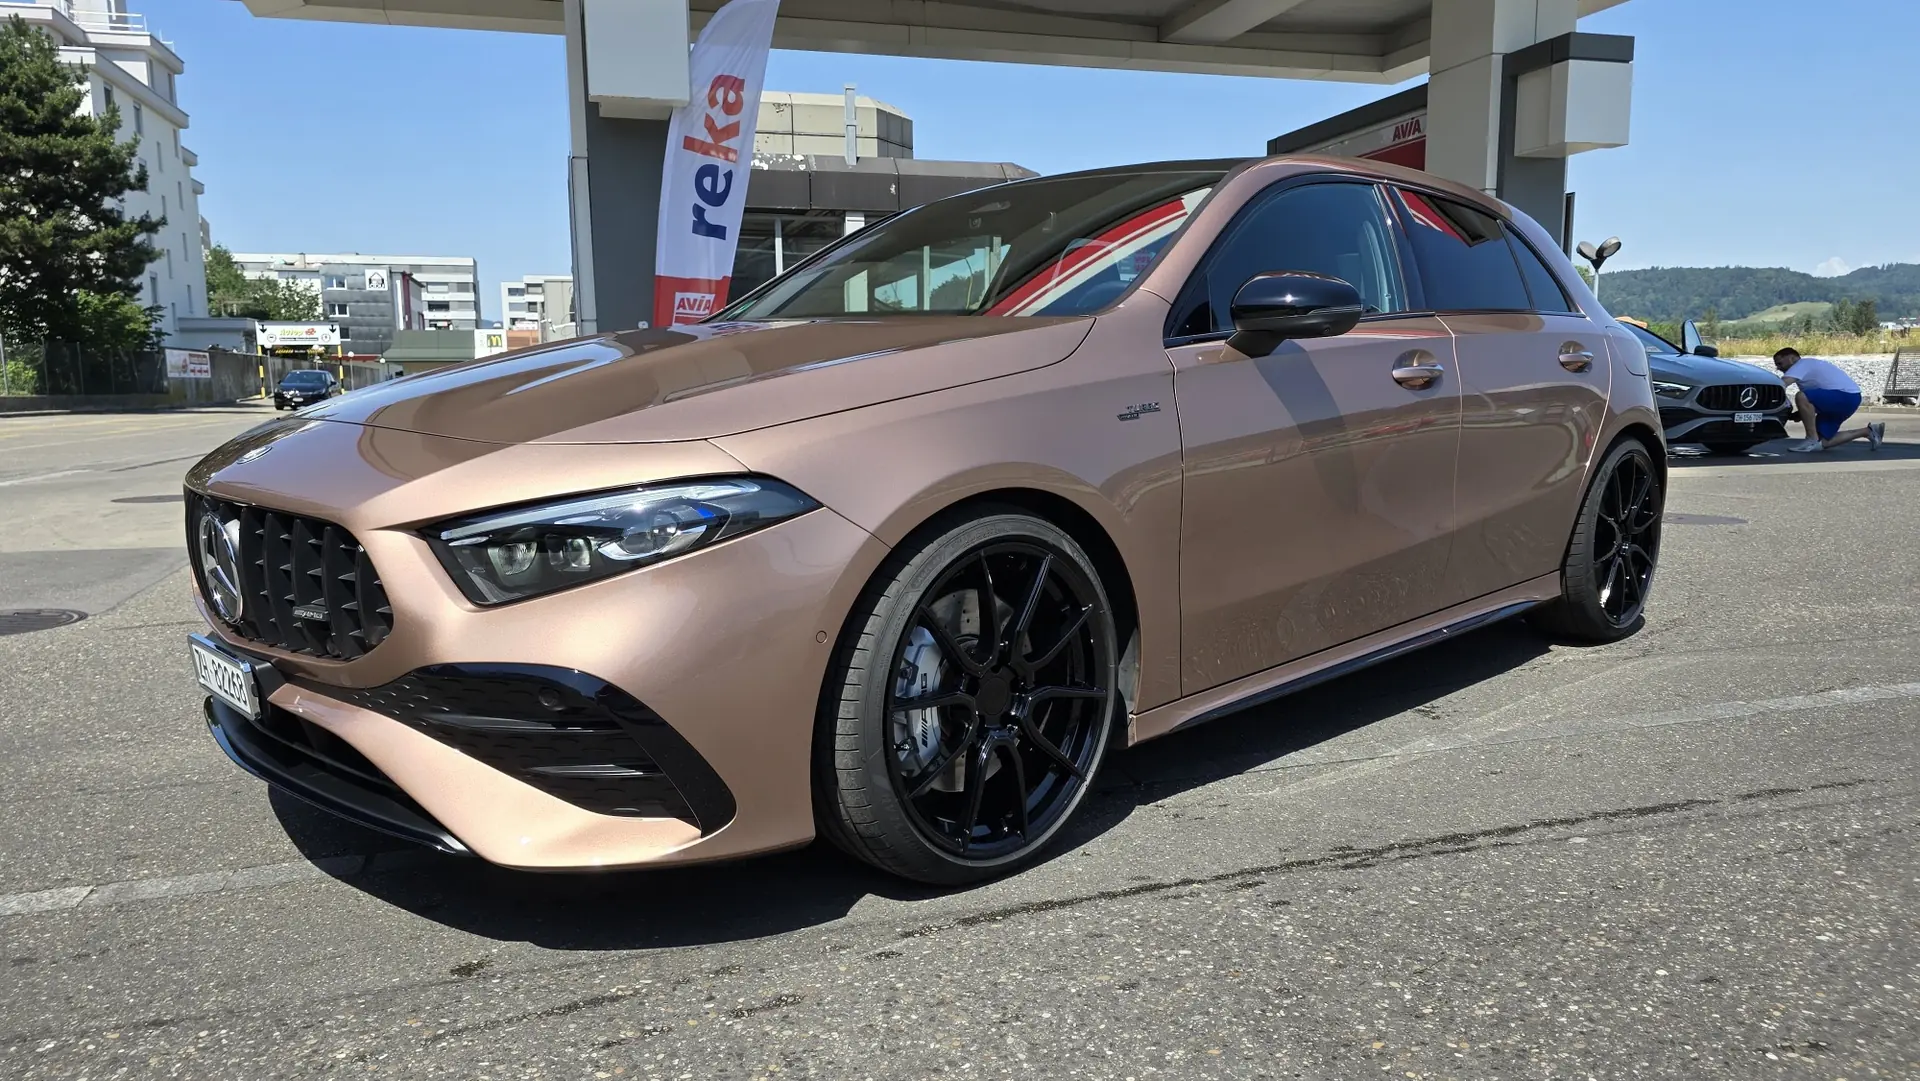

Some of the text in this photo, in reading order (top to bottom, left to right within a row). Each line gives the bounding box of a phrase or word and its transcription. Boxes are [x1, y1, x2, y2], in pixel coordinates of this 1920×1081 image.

[1392, 117, 1422, 142] AVIA
[683, 73, 746, 241] reka
[676, 295, 711, 312] AVIA
